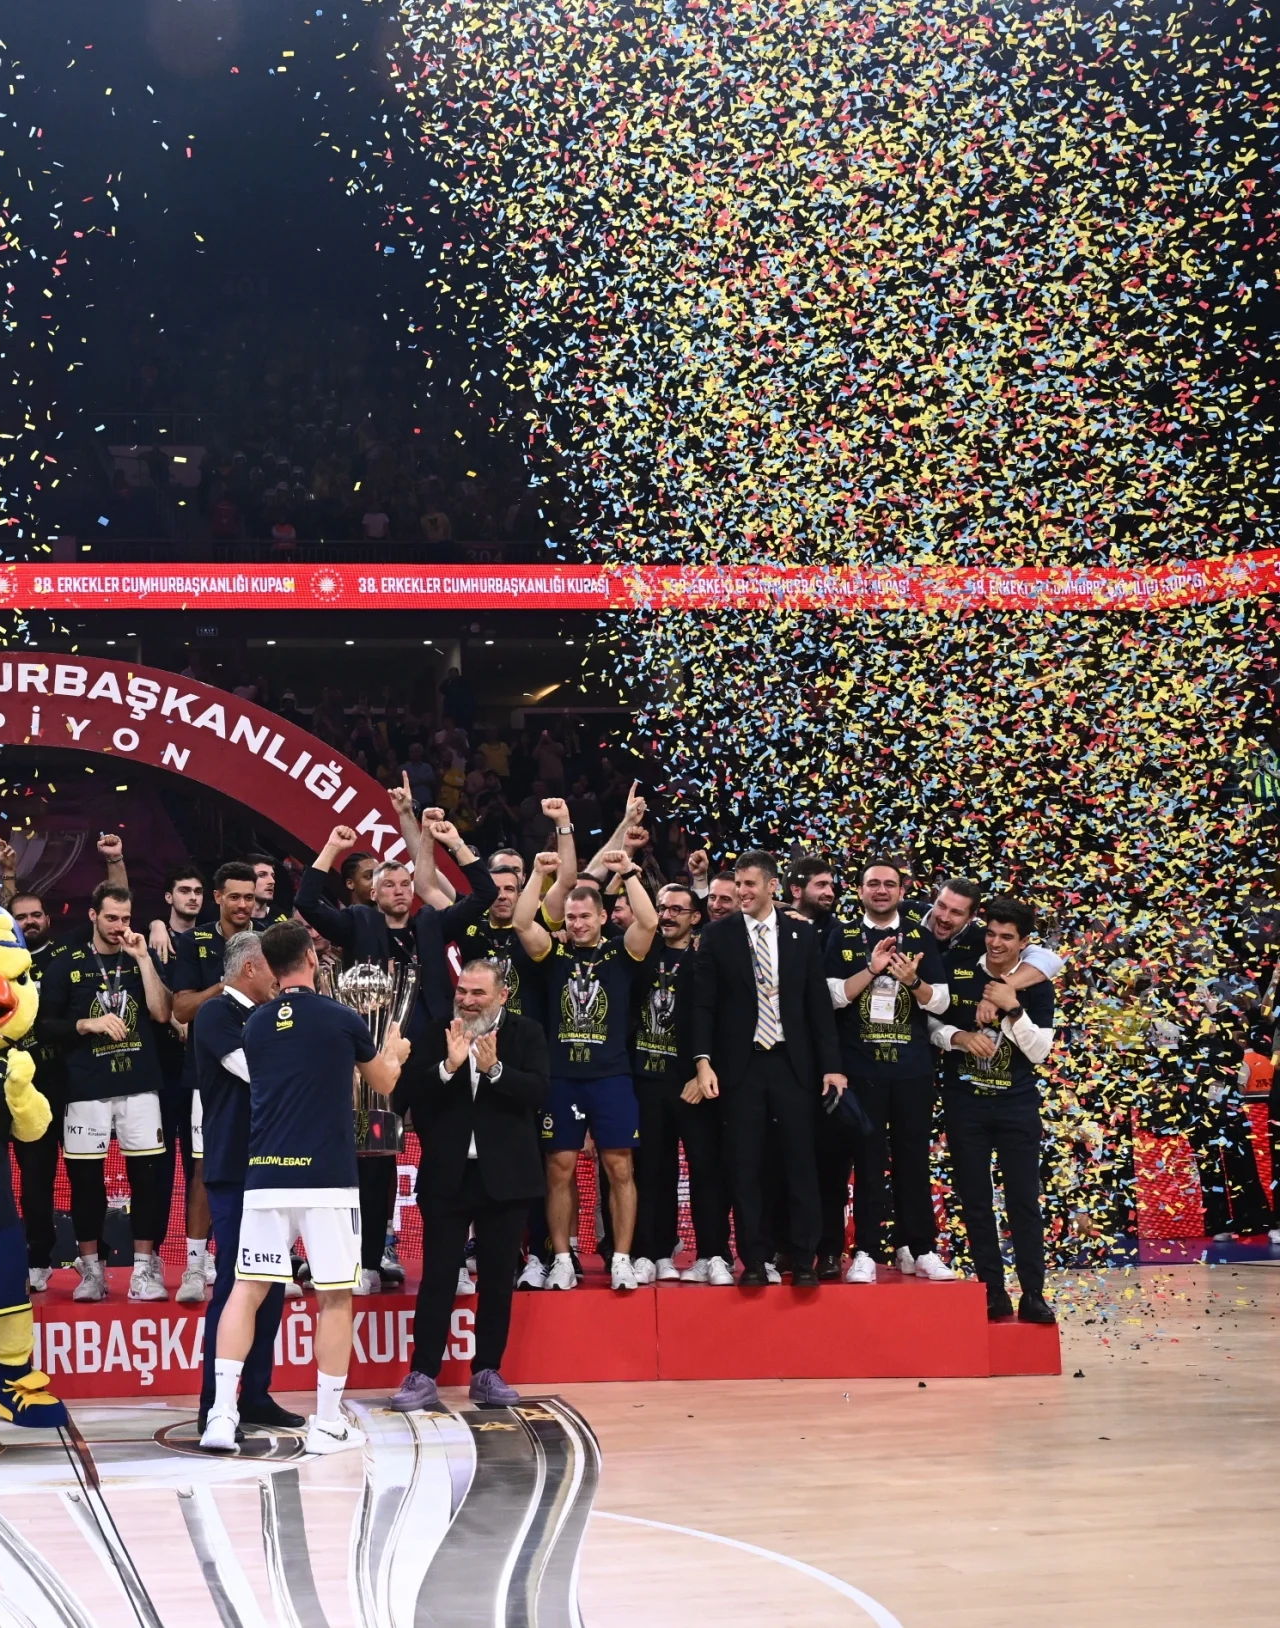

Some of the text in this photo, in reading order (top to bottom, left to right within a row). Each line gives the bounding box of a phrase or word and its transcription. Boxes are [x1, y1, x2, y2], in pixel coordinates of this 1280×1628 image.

[33, 577, 55, 593] 38.
[58, 577, 119, 593] ERKEKLER
[122, 573, 249, 597] CUMHURBAŞKANLIĞI
[358, 574, 609, 597] 38. ERKEKLER CUMHURBAŞKANLIĞI KUPASI
[276, 1020, 293, 1028] beko
[255, 1253, 282, 1264] ENEZ
